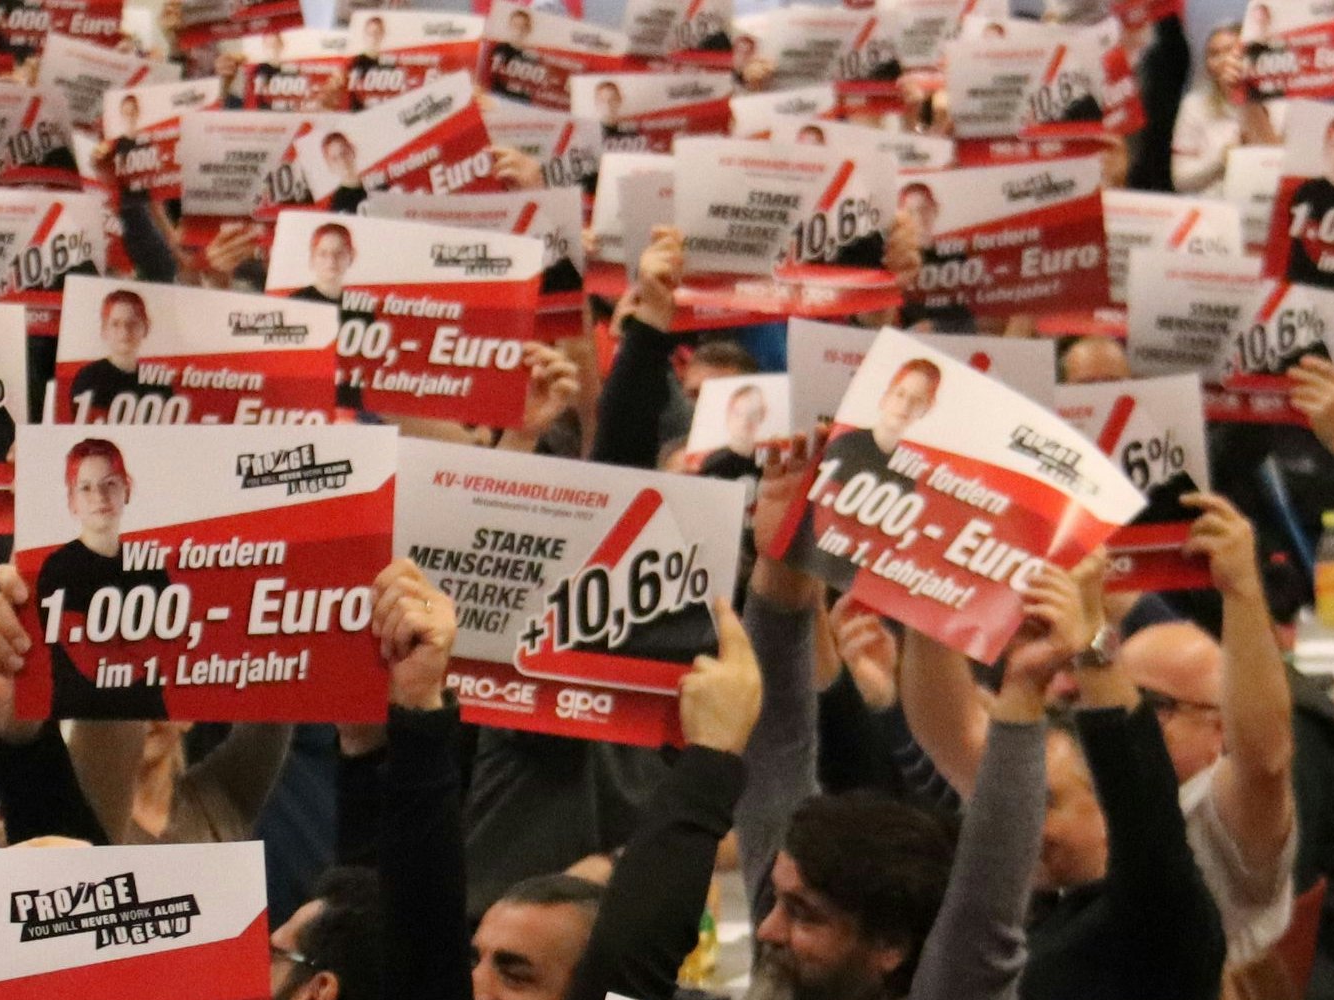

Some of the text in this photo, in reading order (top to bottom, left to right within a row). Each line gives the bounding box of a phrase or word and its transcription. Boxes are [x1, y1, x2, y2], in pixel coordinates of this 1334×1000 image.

[342, 290, 462, 320] Wir fordern
[428, 326, 522, 370] Euro
[433, 470, 610, 509] KV-VERHANDLUNGEN
[886, 444, 1012, 515] Wir fordern
[807, 459, 946, 549] 1.000,-
[122, 537, 286, 572] Wir fordern
[472, 528, 567, 561] STARKE
[408, 545, 546, 588] MENSCHEN,
[872, 547, 977, 610] Lehrjahr!
[40, 578, 374, 650] 1.000,- Euro
[439, 578, 530, 611] STARKE
[521, 543, 708, 651] +10,6%
[175, 650, 311, 690] Lehrjahr!
[555, 689, 613, 719] gpa
[27, 901, 192, 938] YOU WILL NEVER WORK ALONE
[100, 916, 189, 946] JUGEND
